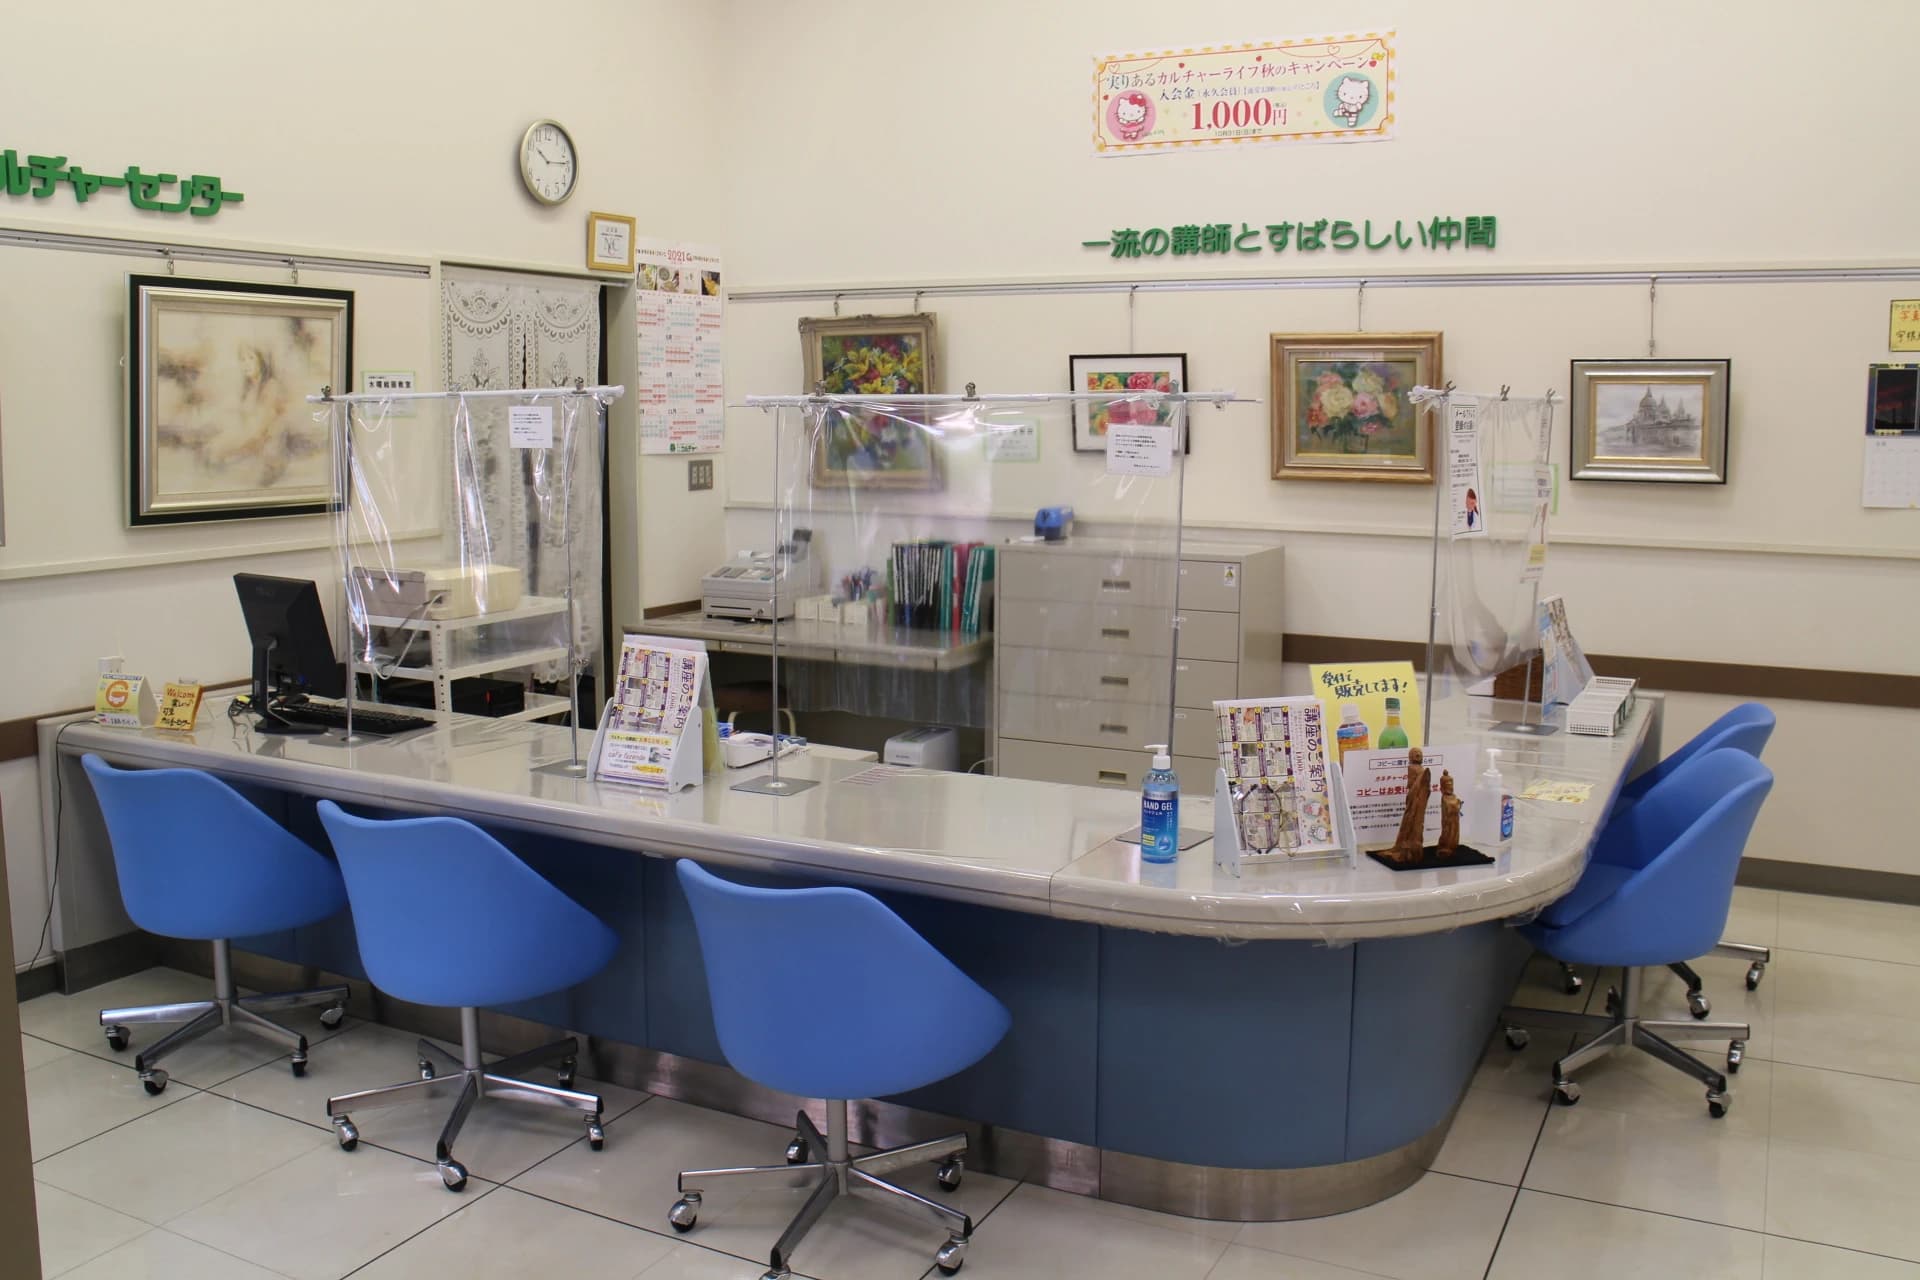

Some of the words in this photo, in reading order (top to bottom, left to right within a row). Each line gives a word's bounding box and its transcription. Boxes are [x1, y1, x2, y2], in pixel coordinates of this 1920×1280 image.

[1082, 216, 1497, 258] 一流の講師とすばらしい仲間
[1321, 669, 1352, 688] 受付で
[1303, 707, 1325, 793] 講座のご案内
[1161, 802, 1173, 811] GEL
